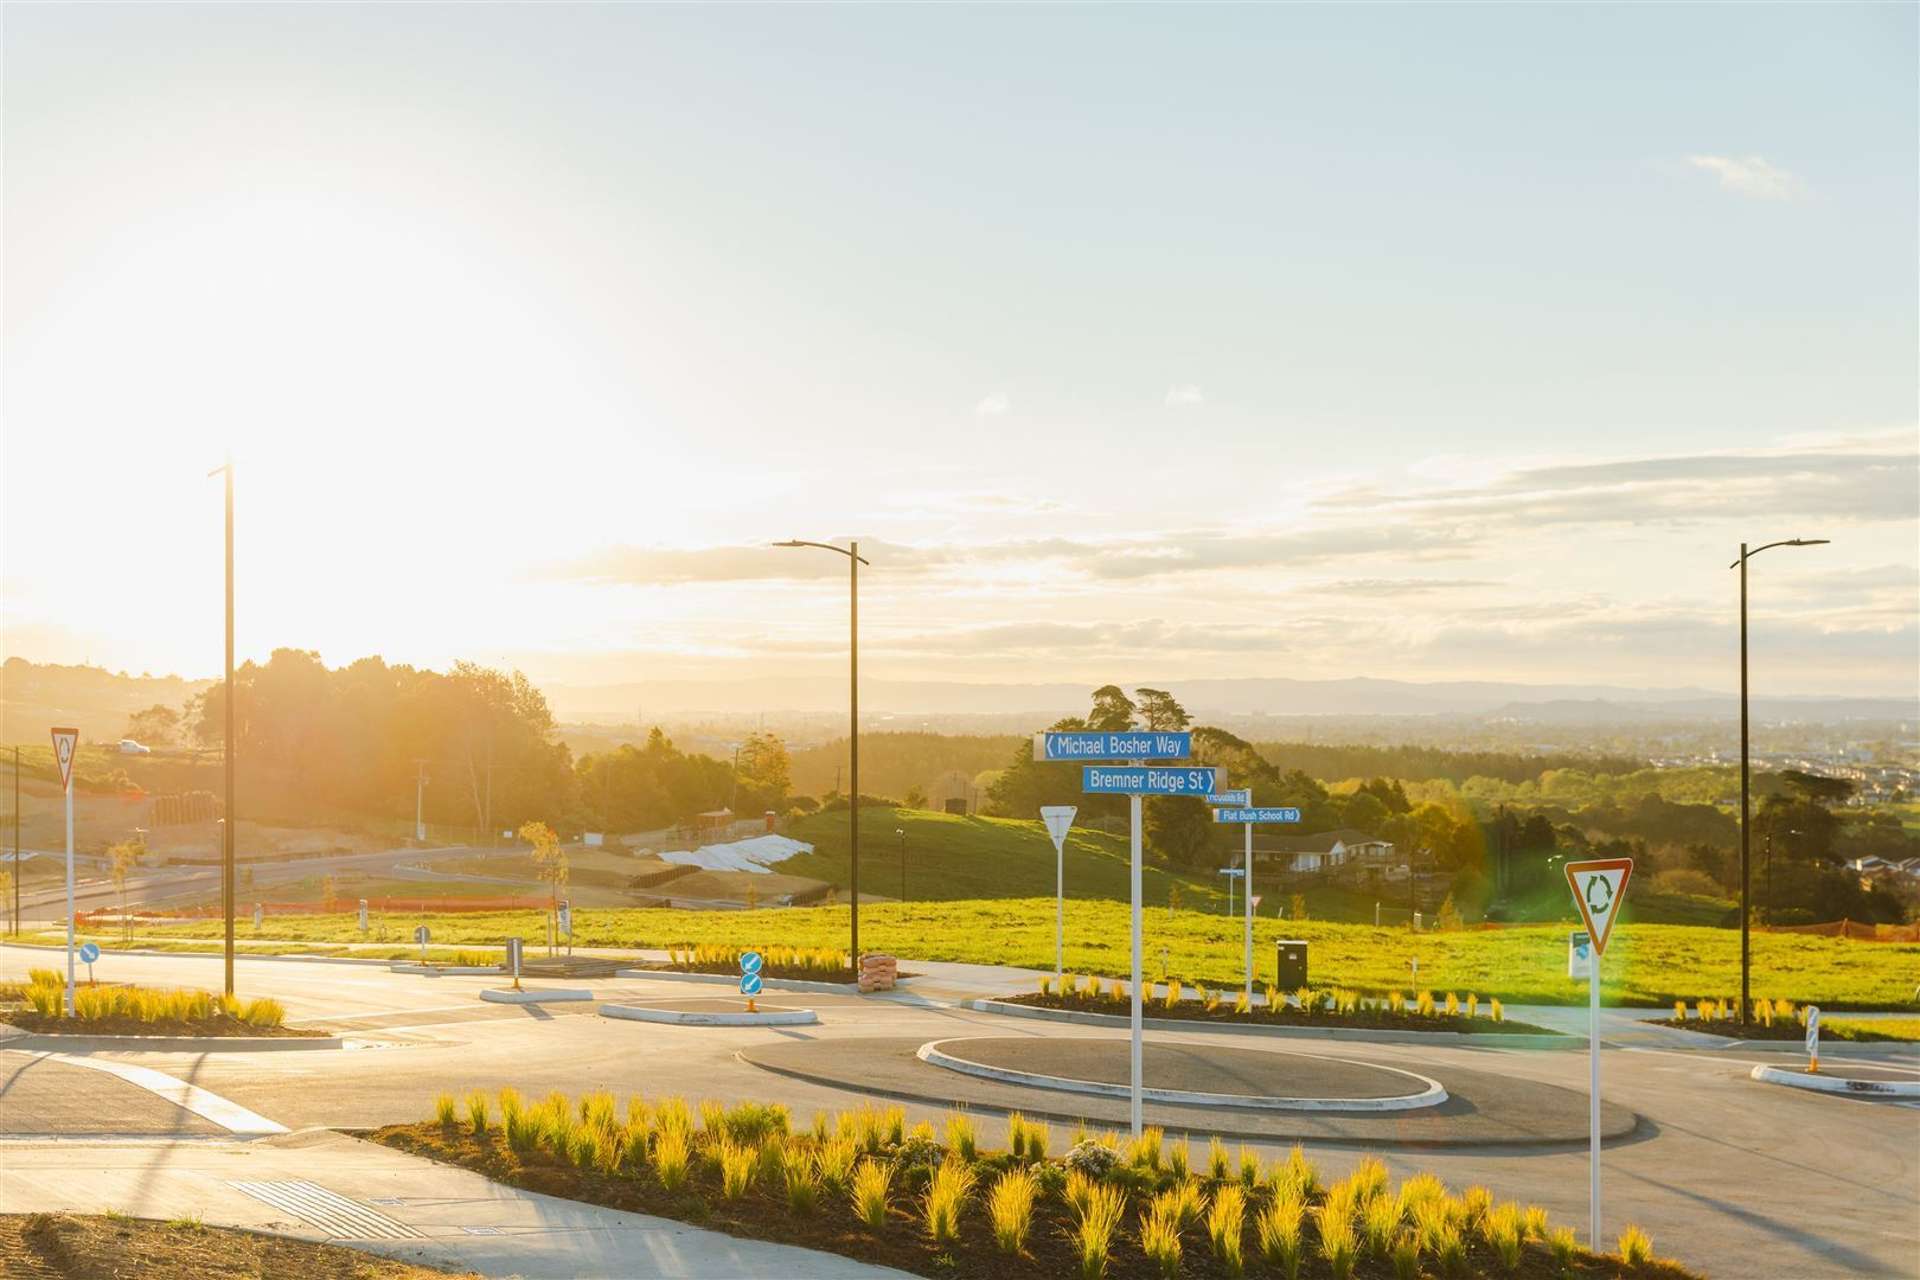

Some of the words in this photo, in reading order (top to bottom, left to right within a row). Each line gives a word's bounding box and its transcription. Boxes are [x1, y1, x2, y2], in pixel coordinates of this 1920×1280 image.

[1057, 737, 1104, 754] Michael
[1110, 736, 1152, 754] Bosher
[1156, 736, 1182, 756] Way
[1090, 770, 1144, 788] Bremner
[1148, 771, 1184, 793] Ridge
[1188, 771, 1203, 790] St
[1223, 810, 1237, 820] Flat
[1239, 810, 1256, 820] Bush
[1258, 809, 1282, 821] School
[1284, 810, 1294, 820] Rd
